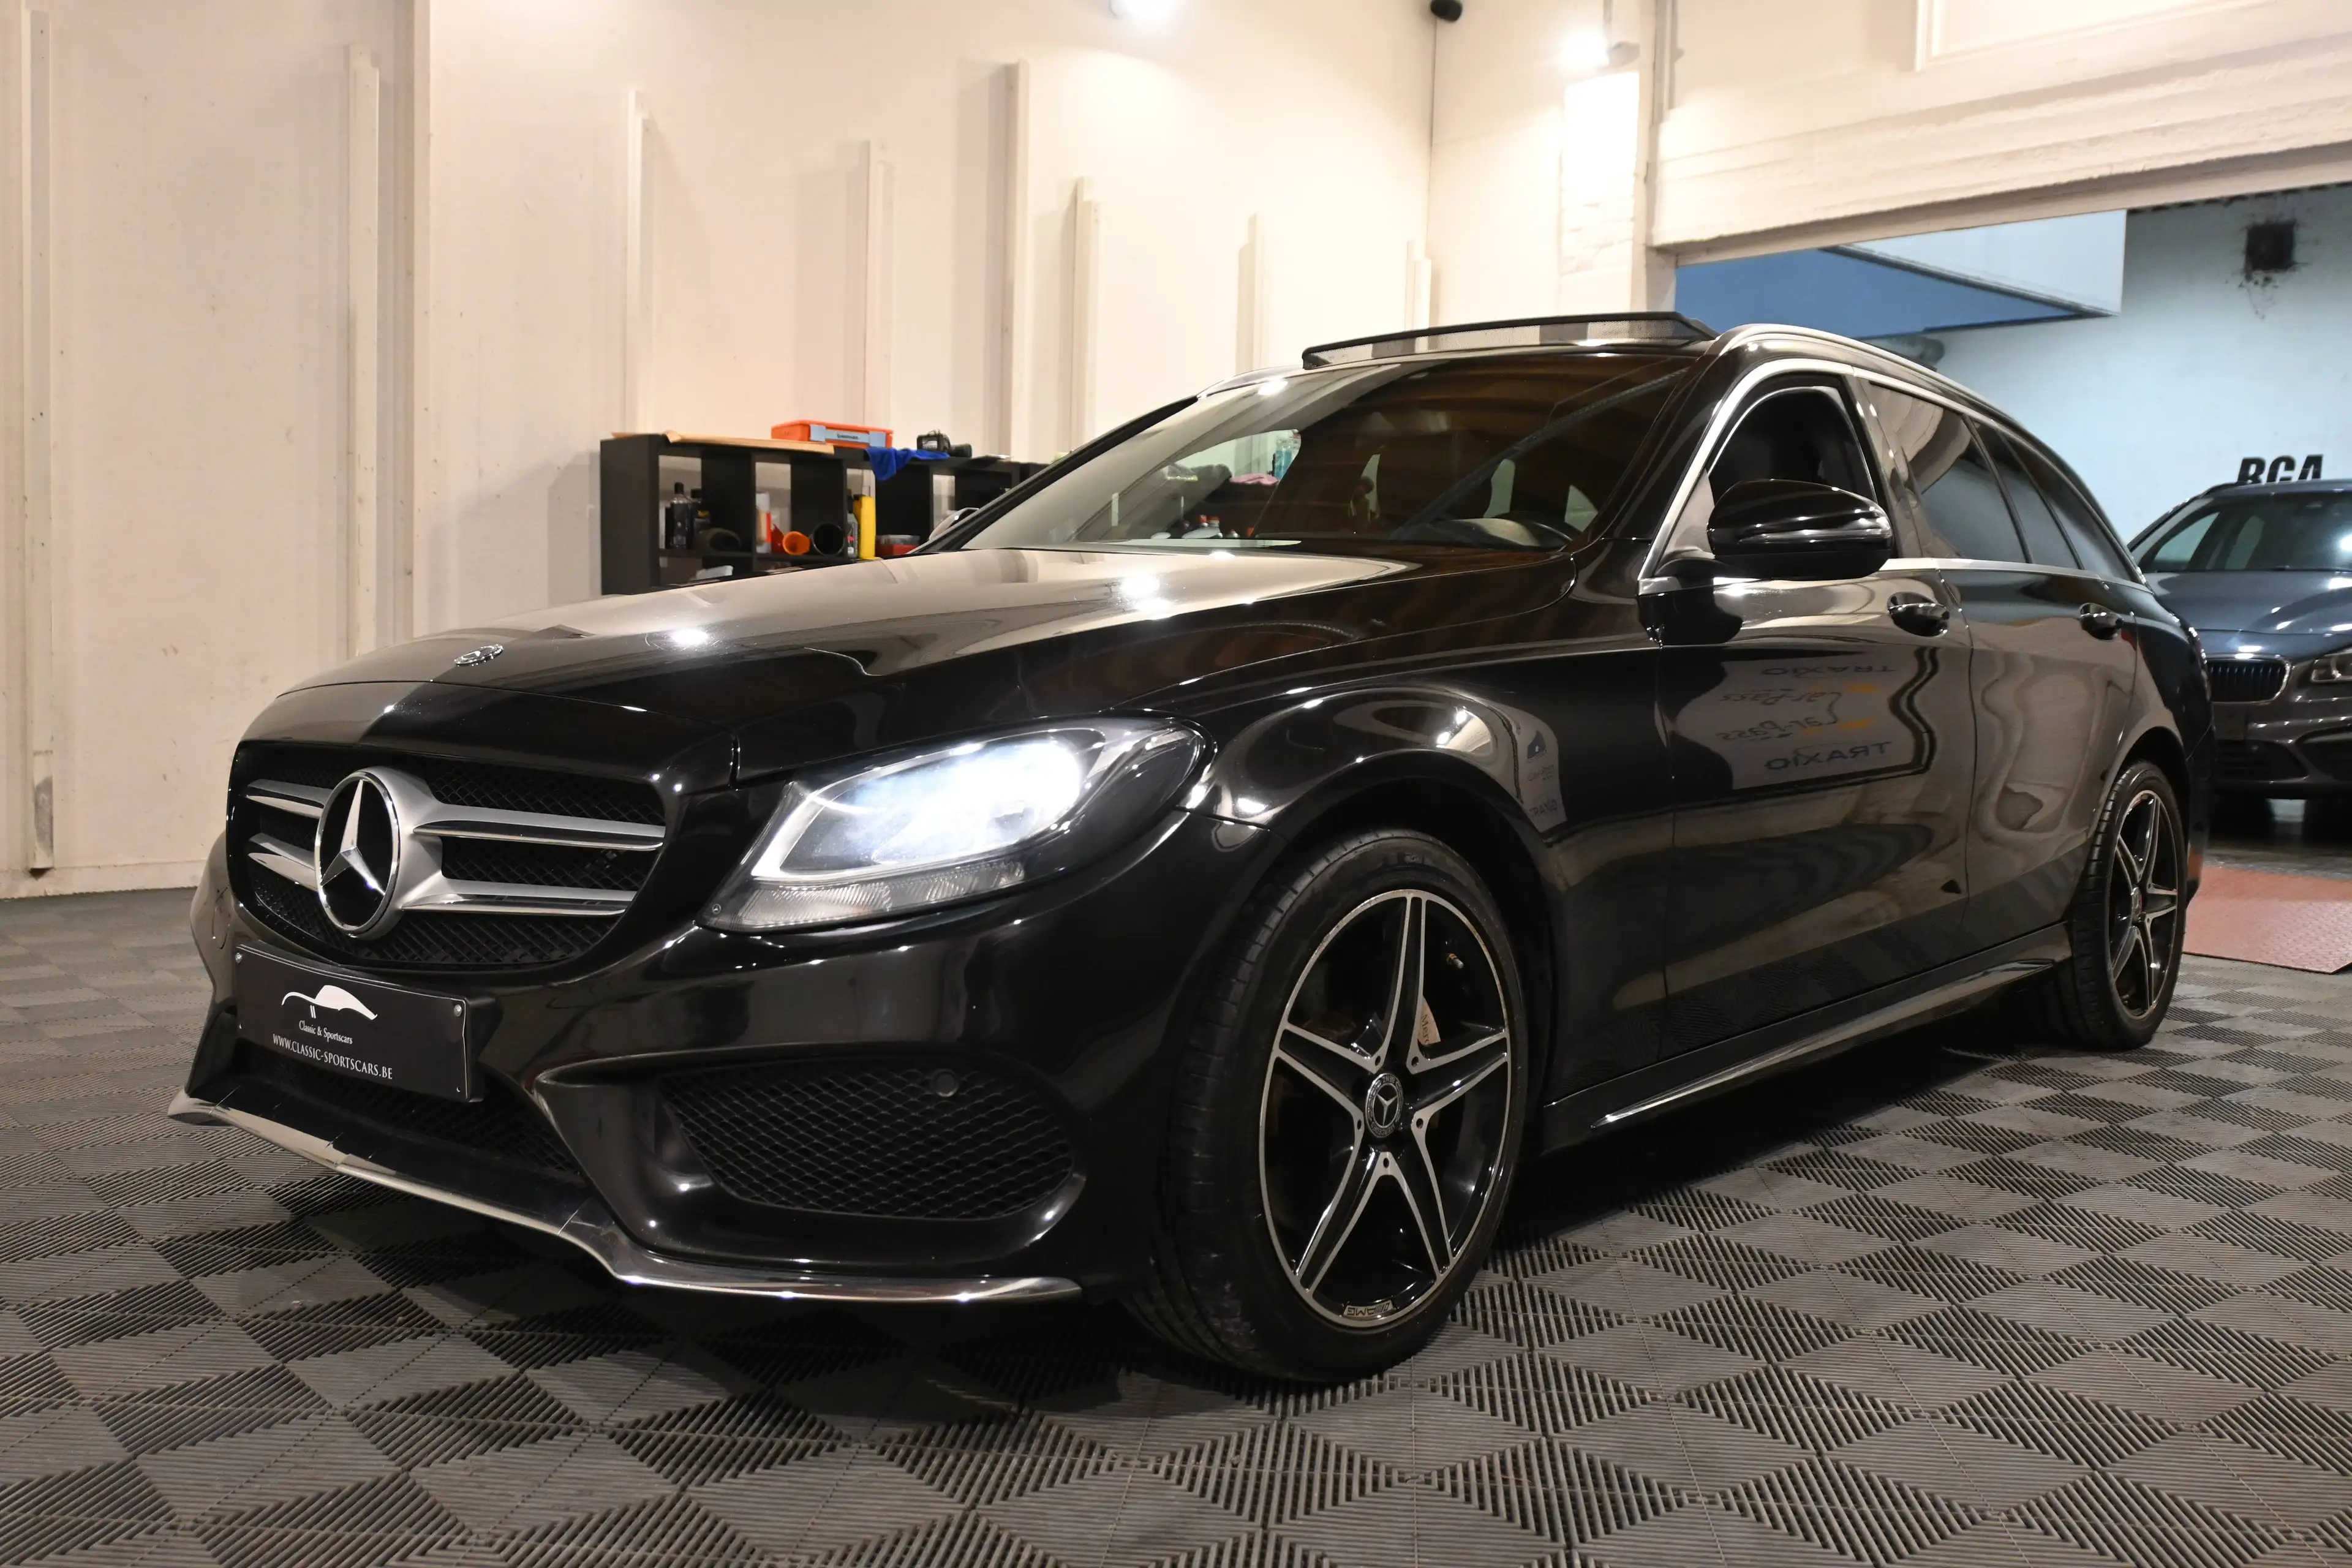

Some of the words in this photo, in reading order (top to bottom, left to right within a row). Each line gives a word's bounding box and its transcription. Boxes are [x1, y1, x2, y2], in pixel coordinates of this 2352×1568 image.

[299, 1020, 316, 1036] Classic
[317, 1026, 322, 1036] &
[323, 1027, 353, 1045] Sportscars
[273, 1033, 393, 1080] WWW.CLASSIC-SPORTSCARS.BE
